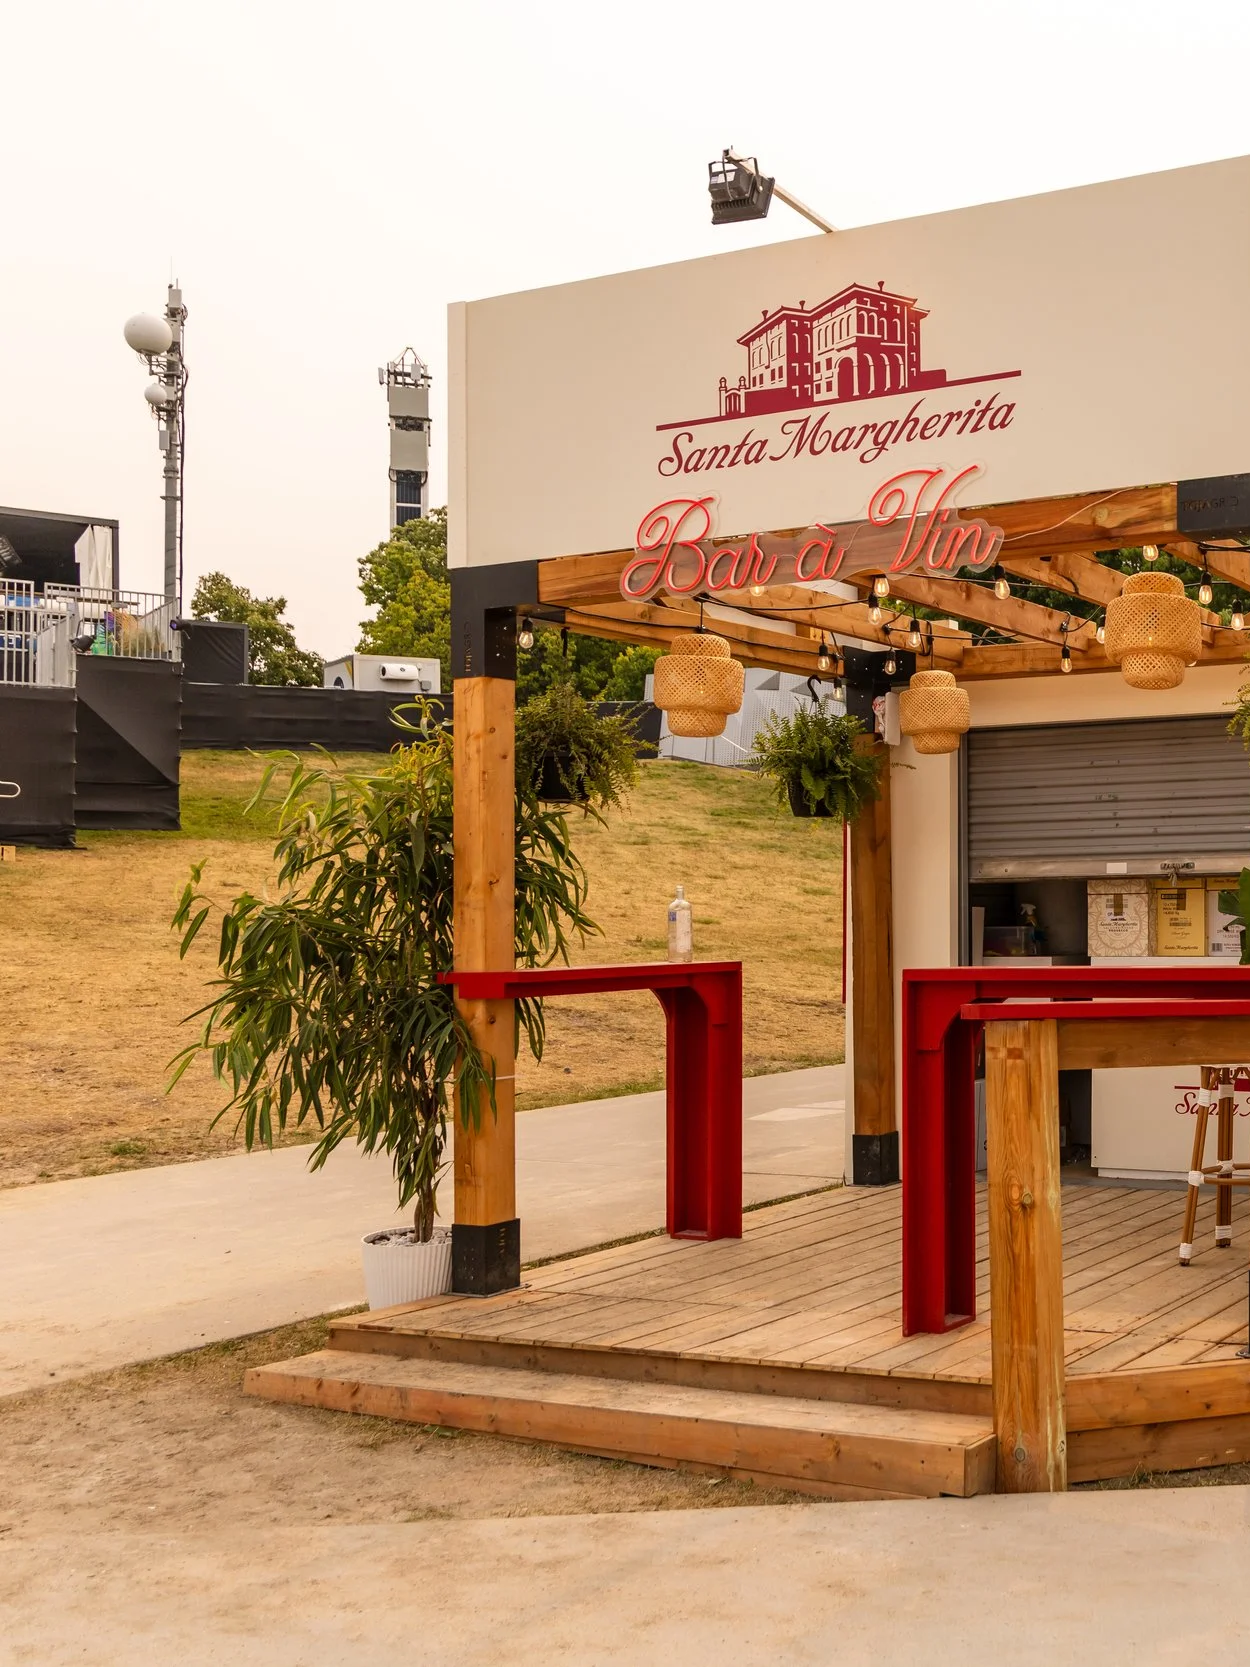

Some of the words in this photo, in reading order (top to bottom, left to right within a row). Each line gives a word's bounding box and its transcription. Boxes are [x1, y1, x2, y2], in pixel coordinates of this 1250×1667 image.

[657, 430, 769, 477] Santa
[768, 392, 1017, 464] Margherita
[622, 496, 776, 597] Bar
[795, 522, 846, 582] à
[868, 464, 998, 573] Vin
[1174, 1091, 1238, 1117] Sana
